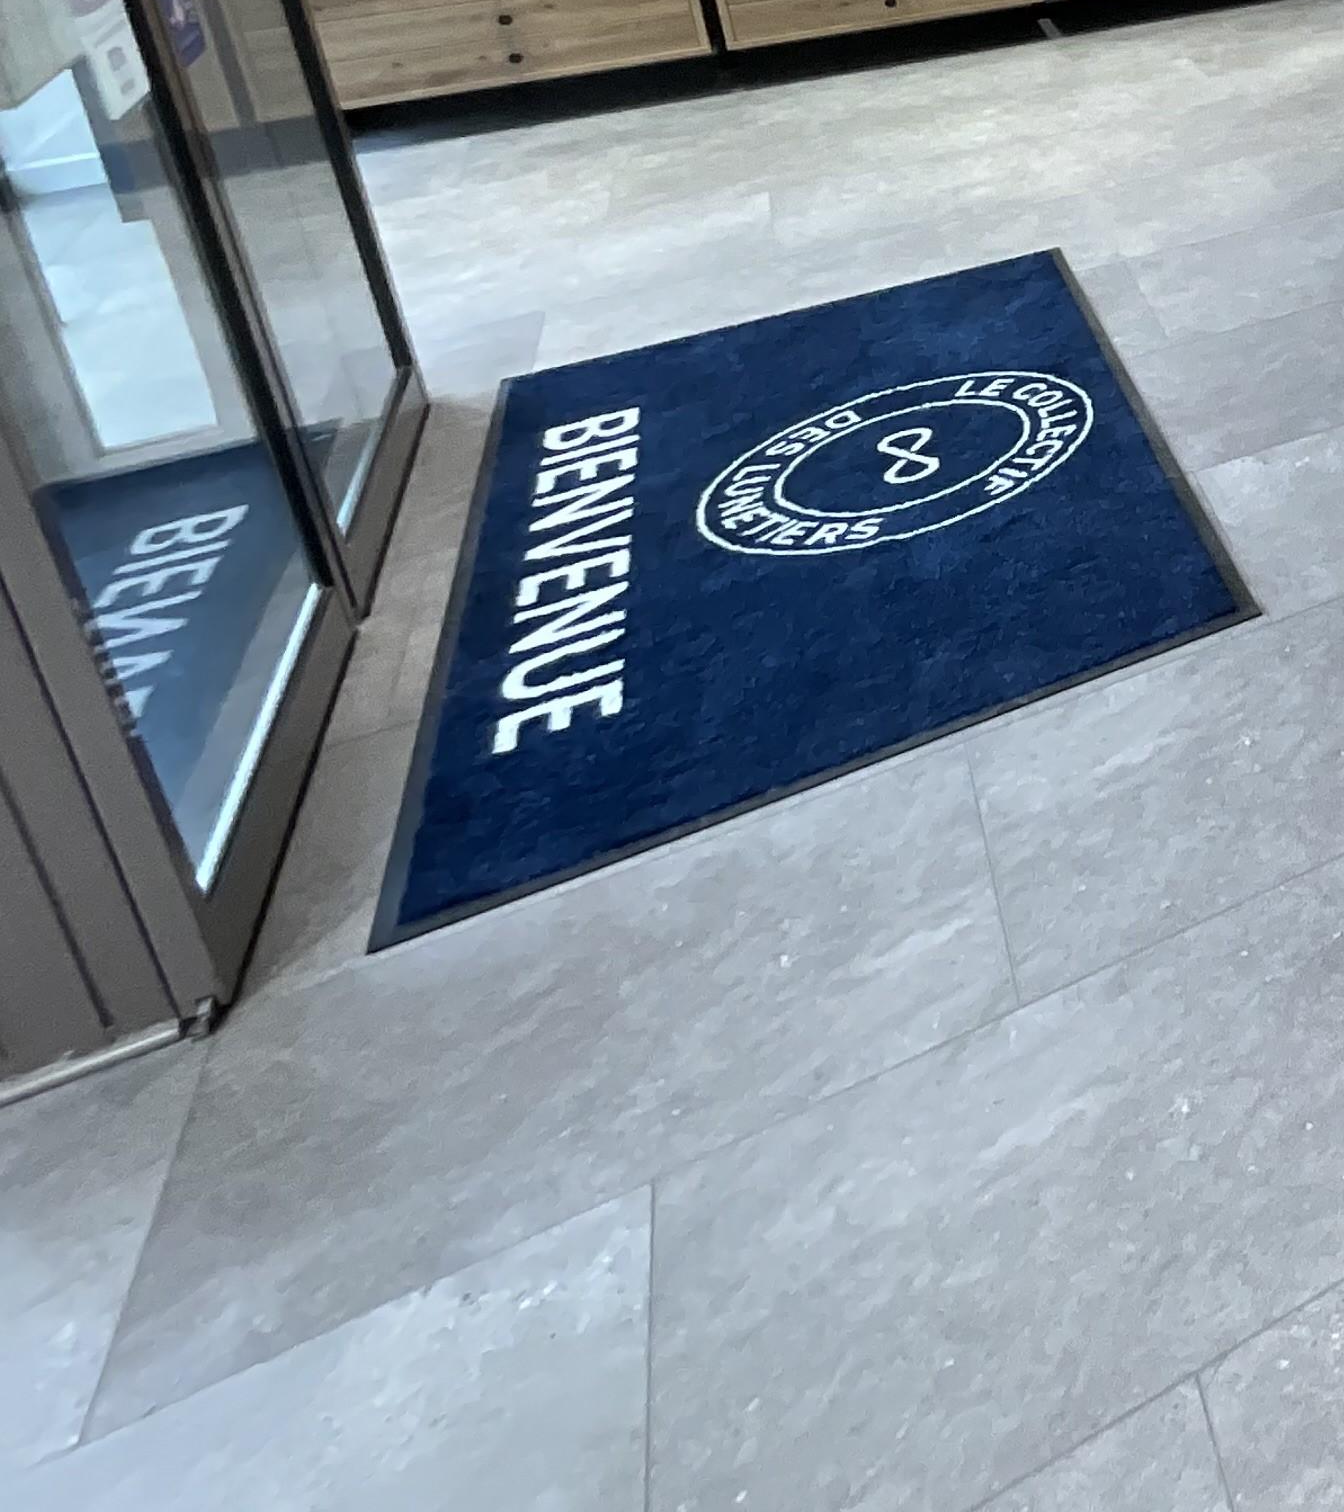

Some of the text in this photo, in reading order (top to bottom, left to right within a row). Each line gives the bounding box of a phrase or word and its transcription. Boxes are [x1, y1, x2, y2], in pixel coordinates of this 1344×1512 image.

[718, 410, 885, 546] DES LUNETIERS
[954, 377, 1079, 497] LE COLLECTIF
[491, 406, 641, 755] BIENVENUE
